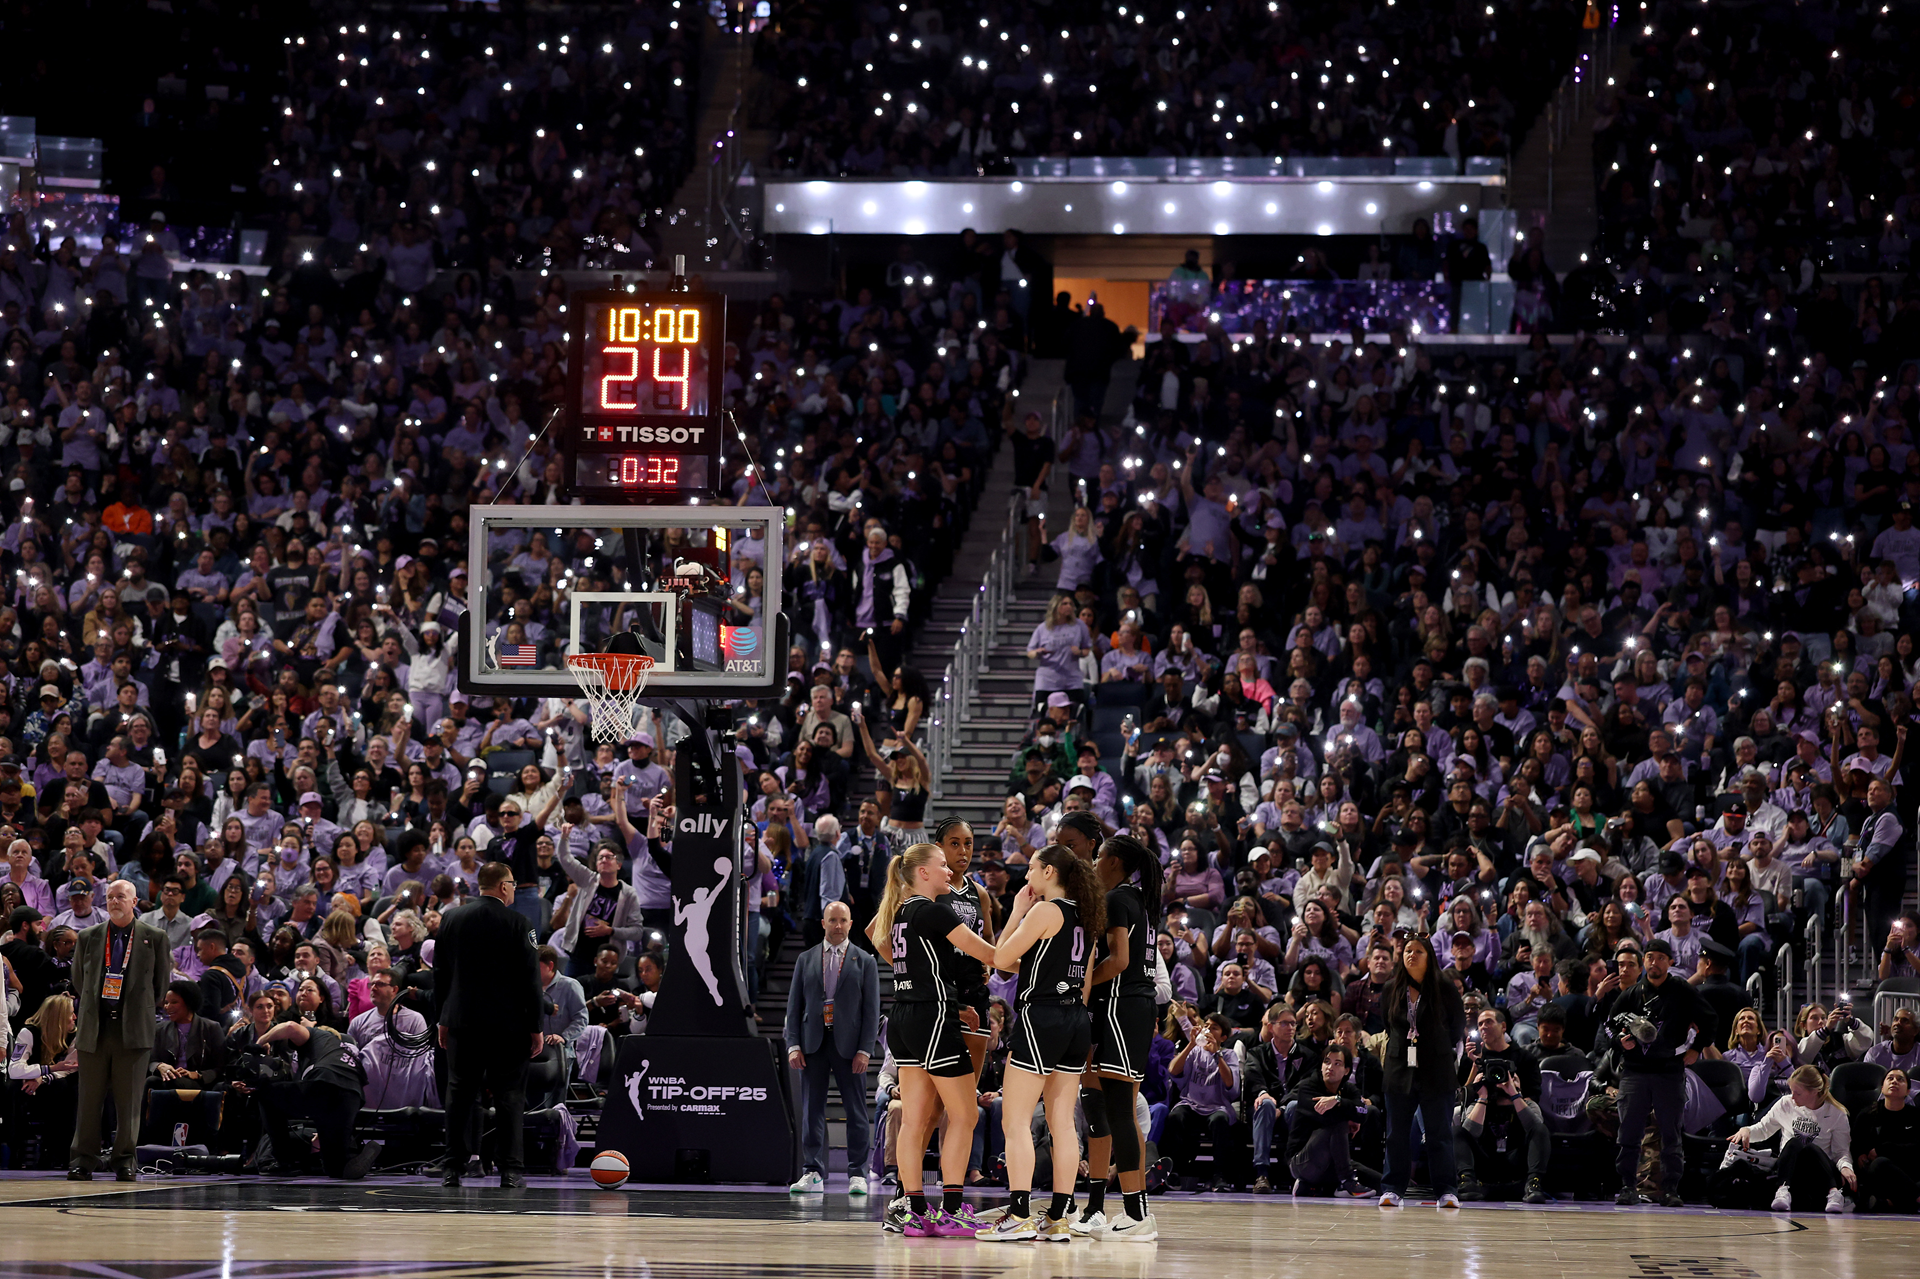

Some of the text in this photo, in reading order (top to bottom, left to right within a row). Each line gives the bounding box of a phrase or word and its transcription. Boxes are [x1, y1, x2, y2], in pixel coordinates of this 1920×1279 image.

[609, 308, 700, 344] 10:00
[600, 346, 690, 411] 24
[616, 426, 705, 444] TISSOT
[622, 457, 679, 485] 0:32
[725, 659, 761, 672] AT&T
[680, 813, 729, 839] ally
[892, 922, 908, 959] 35
[1071, 926, 1085, 962] 0
[1067, 964, 1085, 979] LEITE
[648, 1076, 687, 1085] WNBA
[647, 1086, 768, 1101] TIP-OFF'25
[646, 1103, 671, 1111] Presented
[671, 1103, 678, 1112] by
